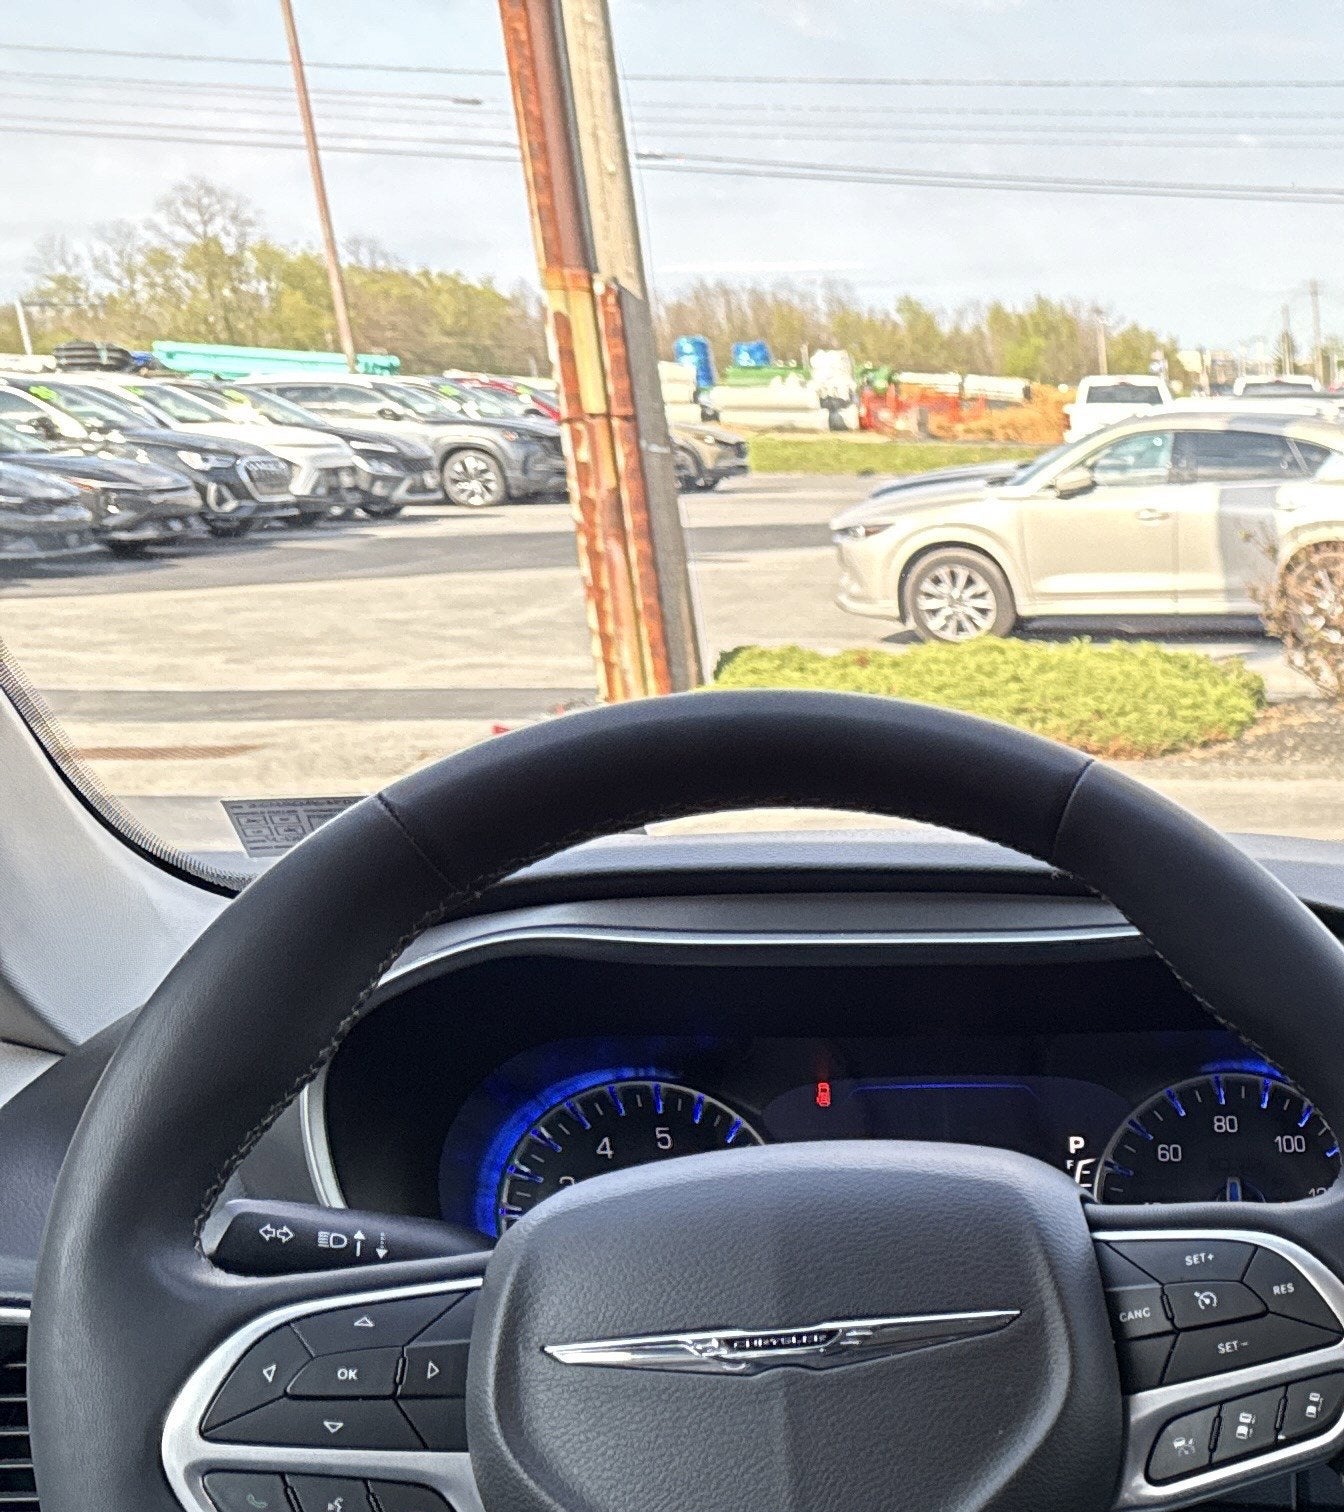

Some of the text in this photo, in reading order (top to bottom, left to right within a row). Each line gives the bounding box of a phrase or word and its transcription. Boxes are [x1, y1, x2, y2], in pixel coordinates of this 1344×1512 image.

[1213, 1115, 1238, 1133] 80
[655, 1127, 674, 1149] 5
[1068, 1136, 1085, 1154] P
[1274, 1135, 1306, 1153] 100
[596, 1136, 614, 1159] 4
[1157, 1144, 1182, 1162] 60
[1272, 1283, 1295, 1295] RES
[1118, 1306, 1151, 1322] CANC
[337, 1368, 358, 1381] OK
